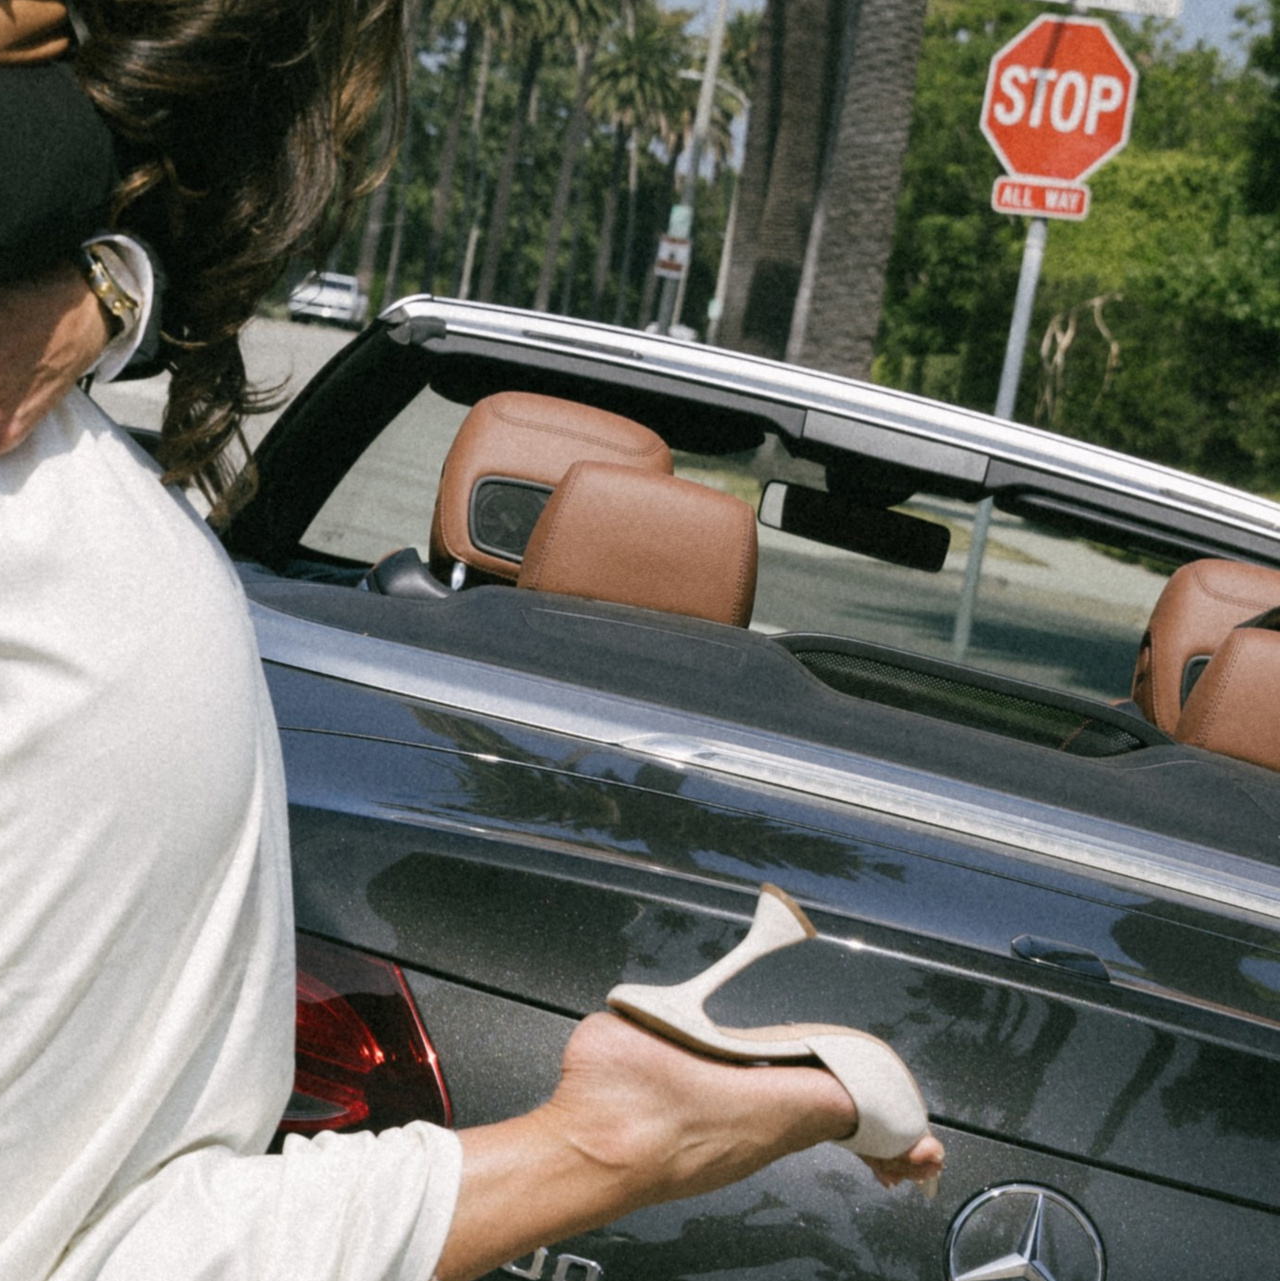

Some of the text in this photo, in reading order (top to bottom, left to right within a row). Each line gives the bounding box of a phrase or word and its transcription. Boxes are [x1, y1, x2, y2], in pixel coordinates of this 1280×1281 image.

[993, 64, 1124, 135] STOP
[1000, 183, 1081, 211] ALL WAY
